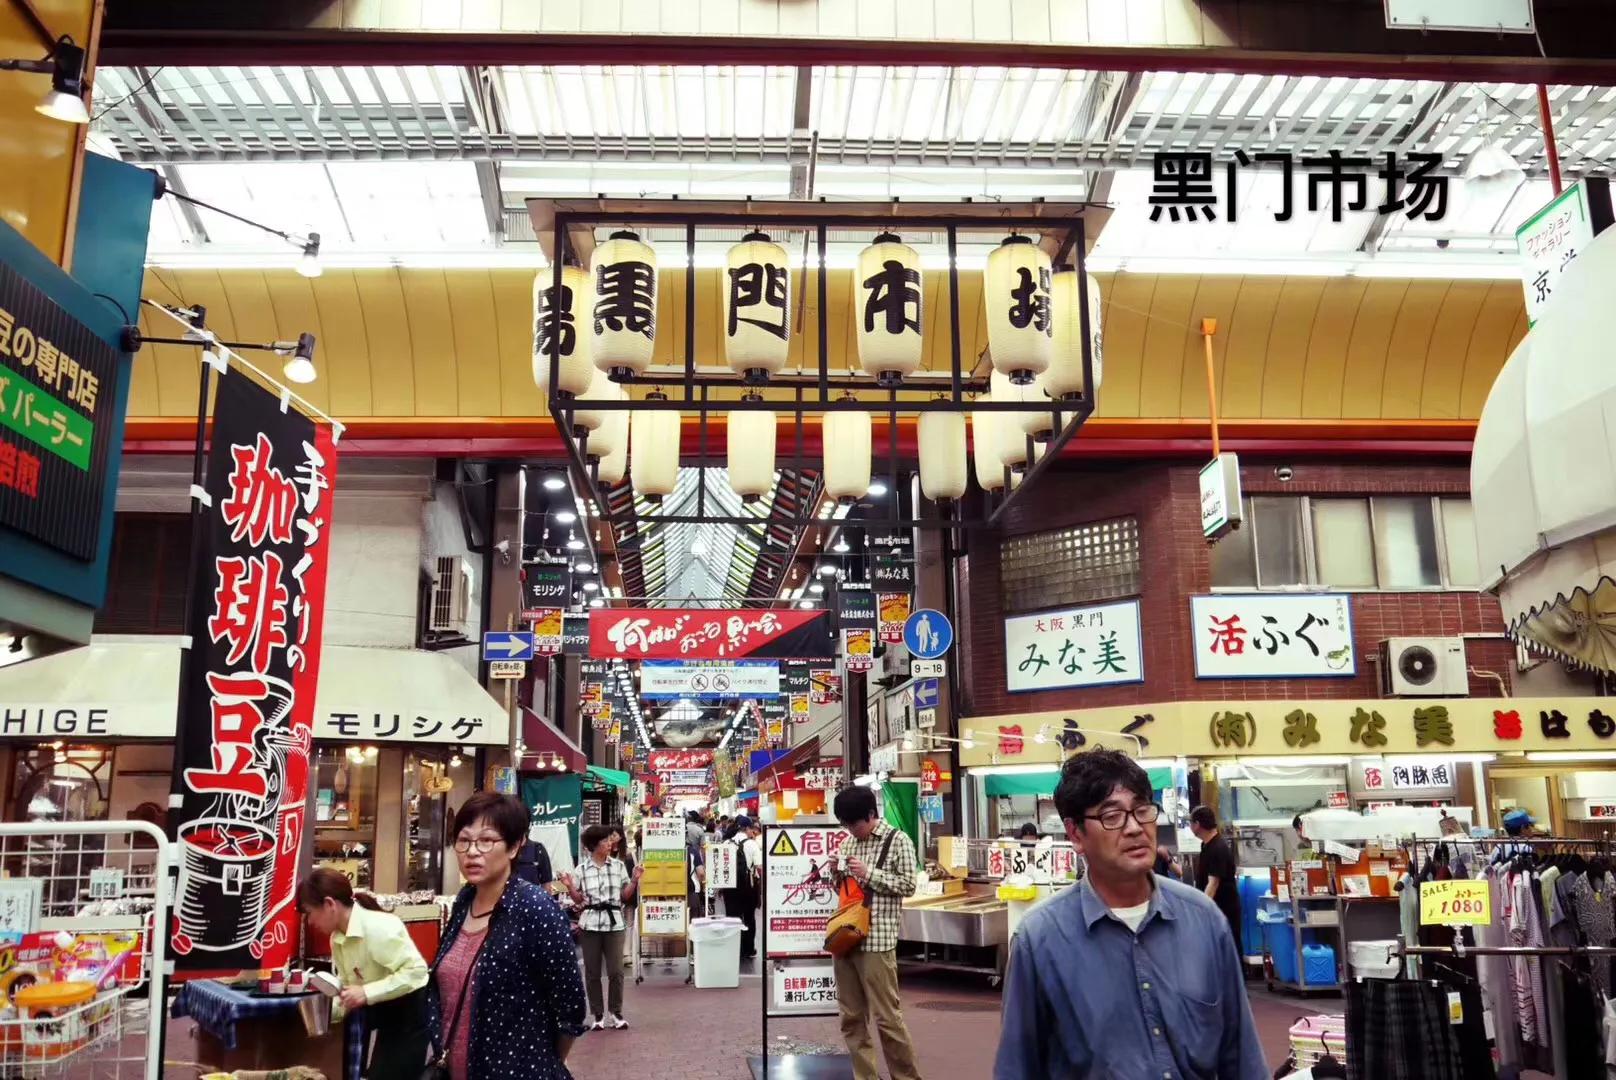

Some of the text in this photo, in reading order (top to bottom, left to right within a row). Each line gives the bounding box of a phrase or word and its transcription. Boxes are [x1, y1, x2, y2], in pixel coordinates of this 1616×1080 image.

[287, 440, 329, 674] 手づくりの
[533, 585, 565, 596] モリシゲ
[183, 432, 299, 798] 珈琲豆
[1035, 611, 1103, 633] 大阪 黒門
[1208, 612, 1330, 657] 活ふぐ
[1018, 630, 1128, 677] みな美
[4, 709, 108, 734] HIGE
[327, 713, 483, 740] モリシゲ
[1209, 706, 1456, 749] (有)みな美
[532, 801, 572, 816] カレー
